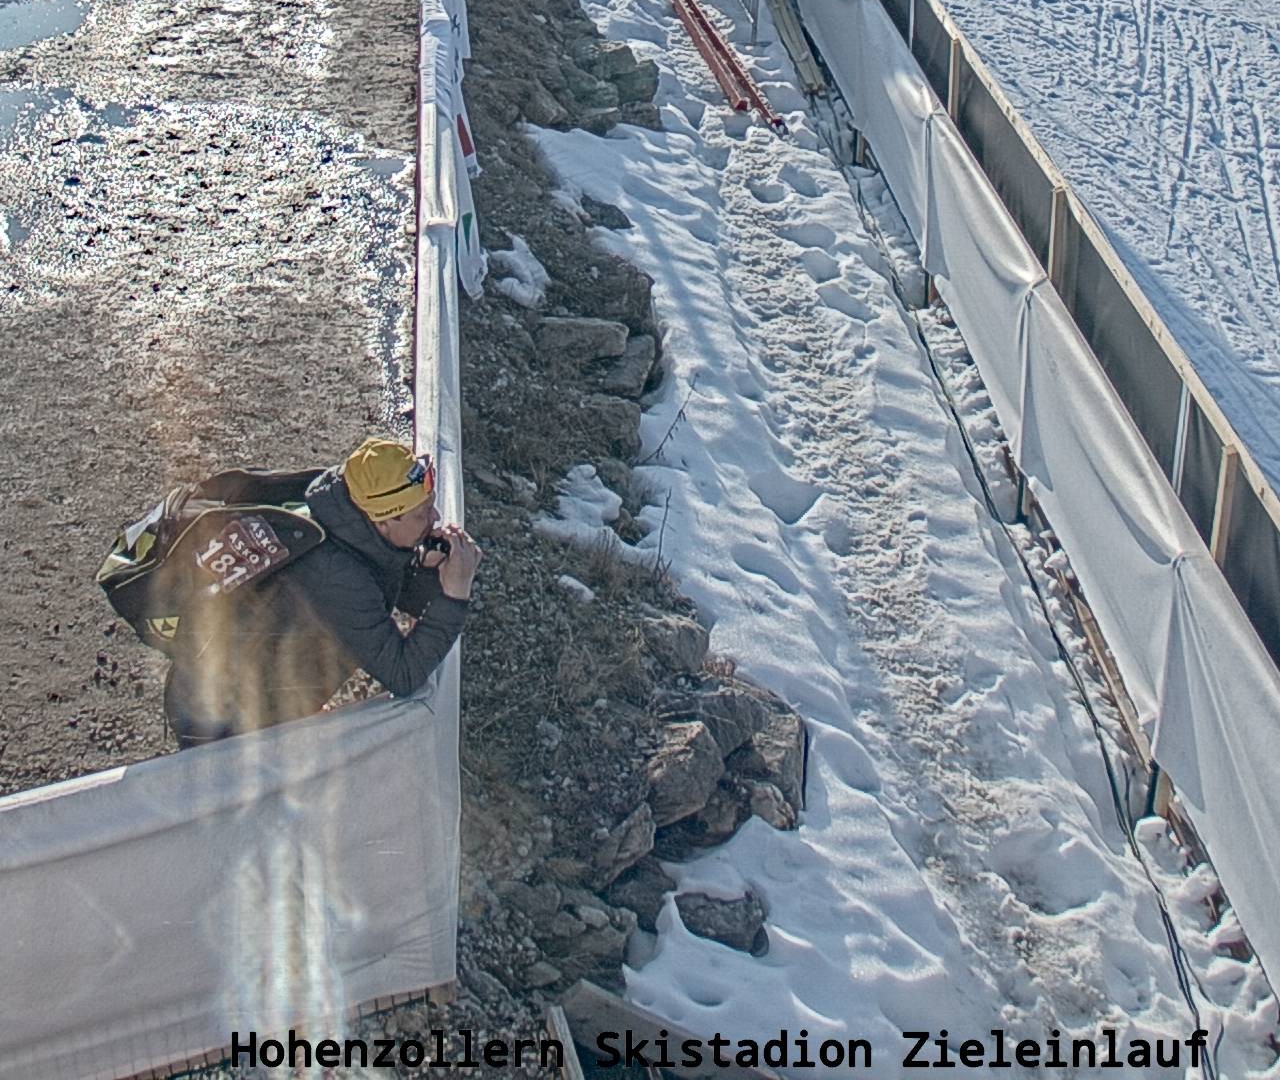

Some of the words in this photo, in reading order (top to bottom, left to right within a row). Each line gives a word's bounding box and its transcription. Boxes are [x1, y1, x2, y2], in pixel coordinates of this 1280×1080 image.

[228, 532, 260, 564] ASKO
[249, 522, 278, 554] ASKO
[200, 538, 248, 586] 181
